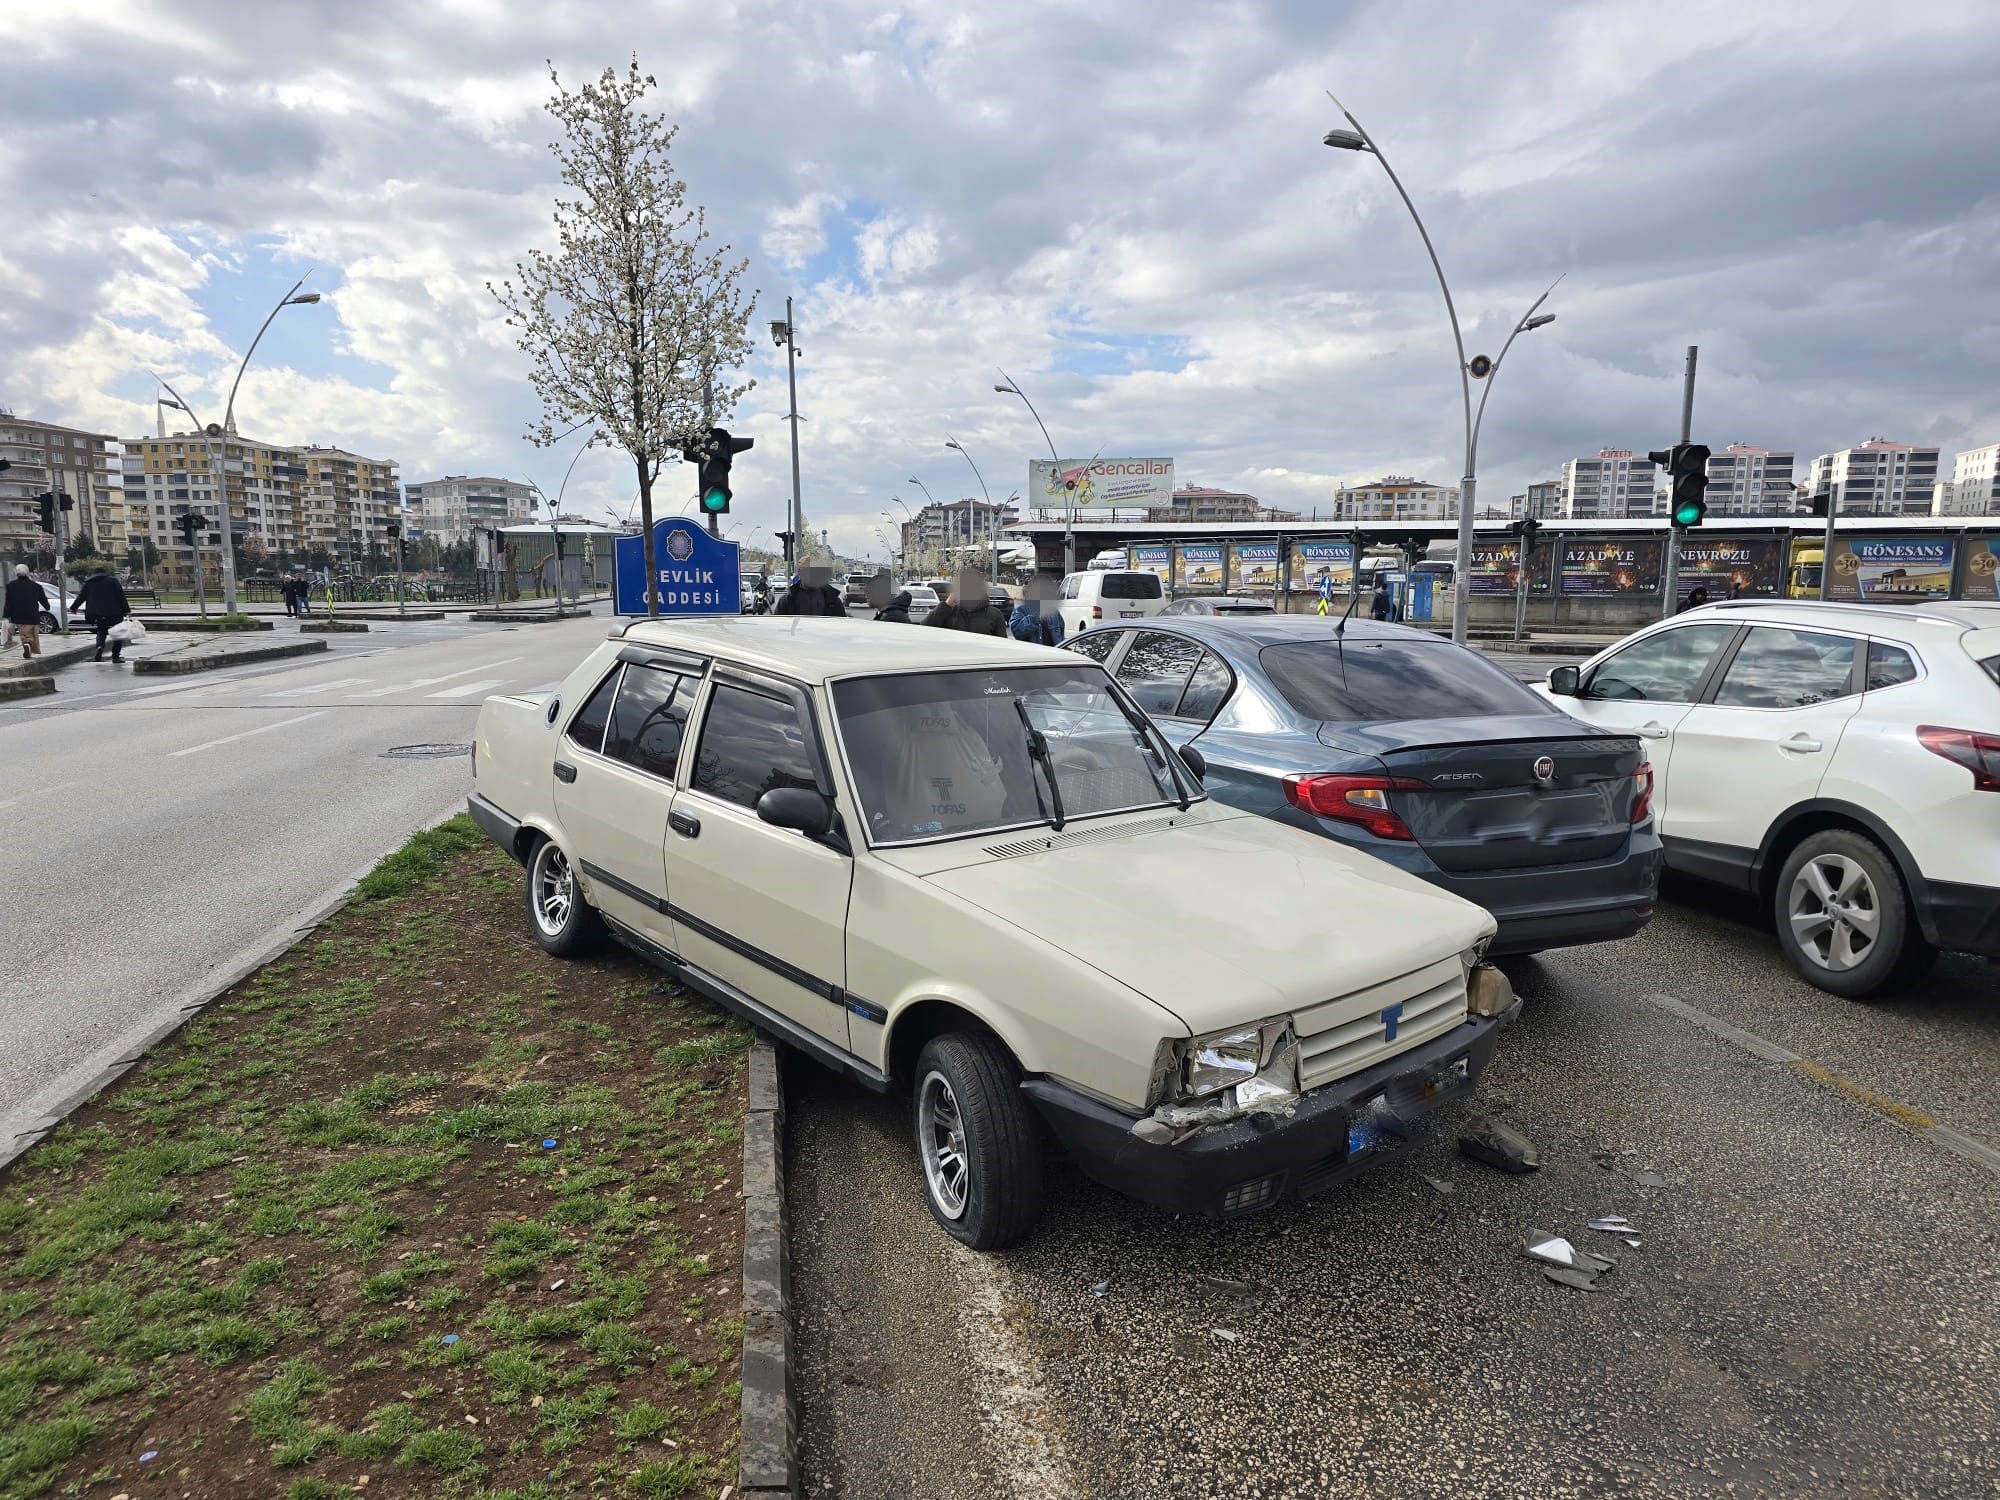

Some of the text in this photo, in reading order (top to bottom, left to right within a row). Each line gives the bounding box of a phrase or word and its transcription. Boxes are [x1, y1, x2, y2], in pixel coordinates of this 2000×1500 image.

[1094, 460, 1171, 475] Gencallar
[1139, 550, 1167, 558] RÖNESANS
[1187, 549, 1219, 558] RÖNESANS
[1307, 546, 1350, 556] RÖNESANS
[1680, 550, 1750, 560] NEWROZU
[1863, 544, 1944, 556] RÖNESANS
[1843, 559, 1858, 570] 30
[1980, 559, 1995, 568] 30
[653, 567, 714, 584] EVLİK
[1539, 763, 1551, 775] FIAT
